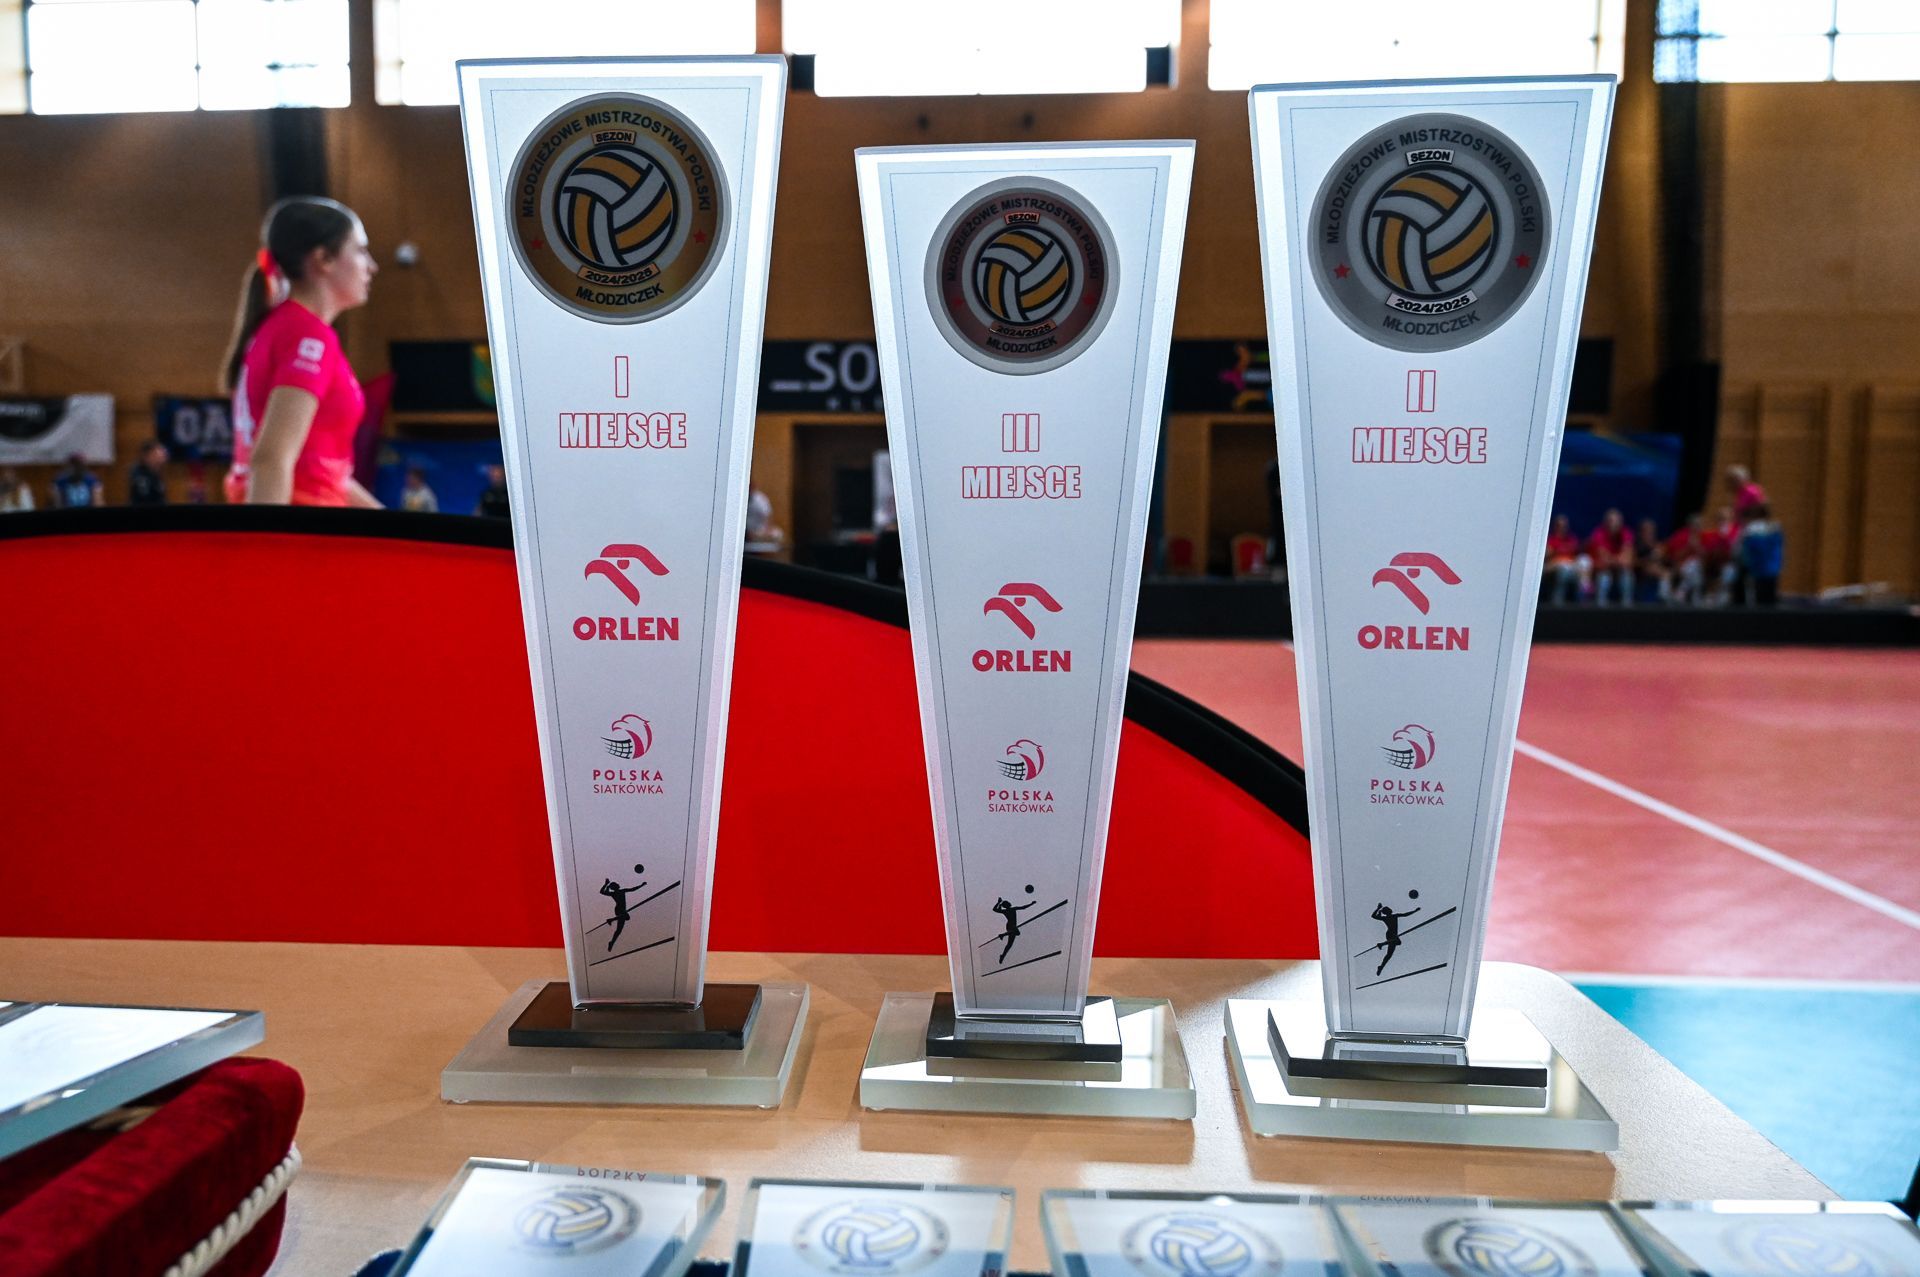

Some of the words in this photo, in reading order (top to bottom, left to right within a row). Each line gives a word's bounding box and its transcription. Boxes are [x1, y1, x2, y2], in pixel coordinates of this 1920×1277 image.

[595, 132, 633, 143] SEZON
[522, 119, 583, 218] MŁODZIEŻOWE
[585, 110, 689, 157] MISTRZOSTWA
[686, 154, 711, 211] POLSKI
[1410, 151, 1450, 163] SEZON
[1327, 139, 1396, 244] MŁODZIEŻOWE
[1399, 128, 1511, 176] MISTRZOSTWA
[1508, 172, 1535, 233] POLSKI
[1008, 213, 1037, 223] SEZON
[1001, 197, 1083, 234] MISTRZOSTWA
[1081, 233, 1100, 280] POLSKI
[586, 268, 653, 286] 2024/2025
[576, 282, 664, 306] MŁODZICZEK
[1395, 295, 1470, 313] 2024/2025
[997, 323, 1051, 337] 2024/2025
[1383, 310, 1480, 336] MŁODZICZEK
[614, 355, 629, 398] I
[1406, 369, 1437, 413] II
[559, 412, 687, 449] MIEJSCE
[1002, 413, 1041, 453] III
[1352, 426, 1487, 465] MIEJSCE
[962, 465, 1081, 499] MIEJSCE
[572, 616, 680, 641] ORLEN
[1357, 624, 1470, 651] ORLEN
[971, 649, 1072, 673] ORLEN
[592, 769, 664, 781] POLSKA
[1370, 779, 1445, 793] POLSKA
[593, 782, 664, 794] SIATKÓWKA
[988, 790, 1054, 801] POLSKA
[1370, 793, 1445, 806] SIATKÓWKA
[988, 802, 1054, 813] SIATKÓWKA
